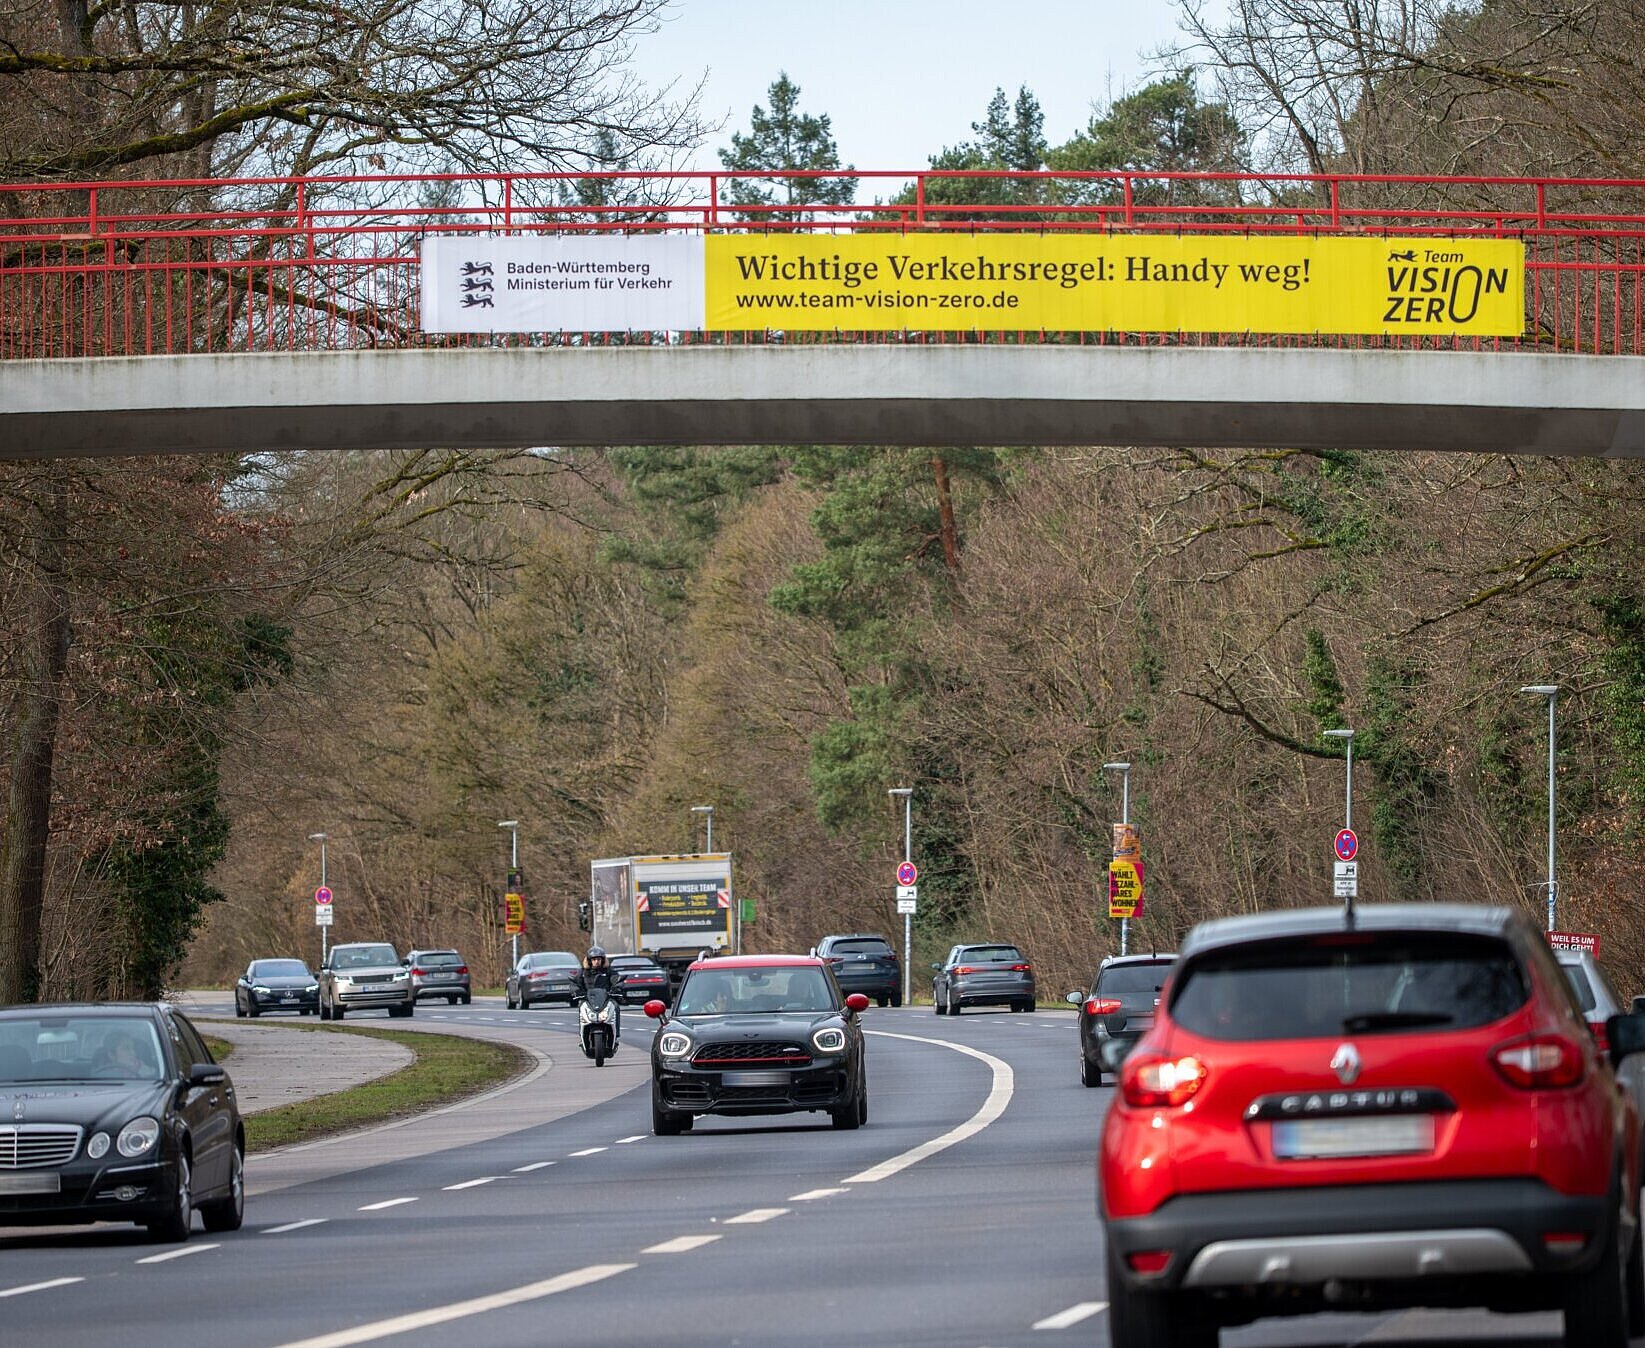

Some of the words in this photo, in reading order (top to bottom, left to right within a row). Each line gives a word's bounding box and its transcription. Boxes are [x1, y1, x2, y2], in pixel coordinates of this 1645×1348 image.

[1424, 250, 1464, 263] Team
[507, 261, 650, 276] Baden-Württemberg
[736, 255, 878, 286] Wichtige
[887, 255, 1115, 288] Verkehrsregel:
[1125, 256, 1228, 288] Handy
[1238, 258, 1312, 291] weg!
[507, 277, 590, 290] Ministerium
[594, 276, 614, 290] für
[618, 276, 672, 290] Verkehr
[736, 291, 1019, 308] www.team-vision-zero.de
[1111, 869, 1134, 879] WÄHLT
[678, 884, 699, 893] UNSER
[700, 884, 717, 892] TEAM
[1551, 935, 1570, 943] WEIL
